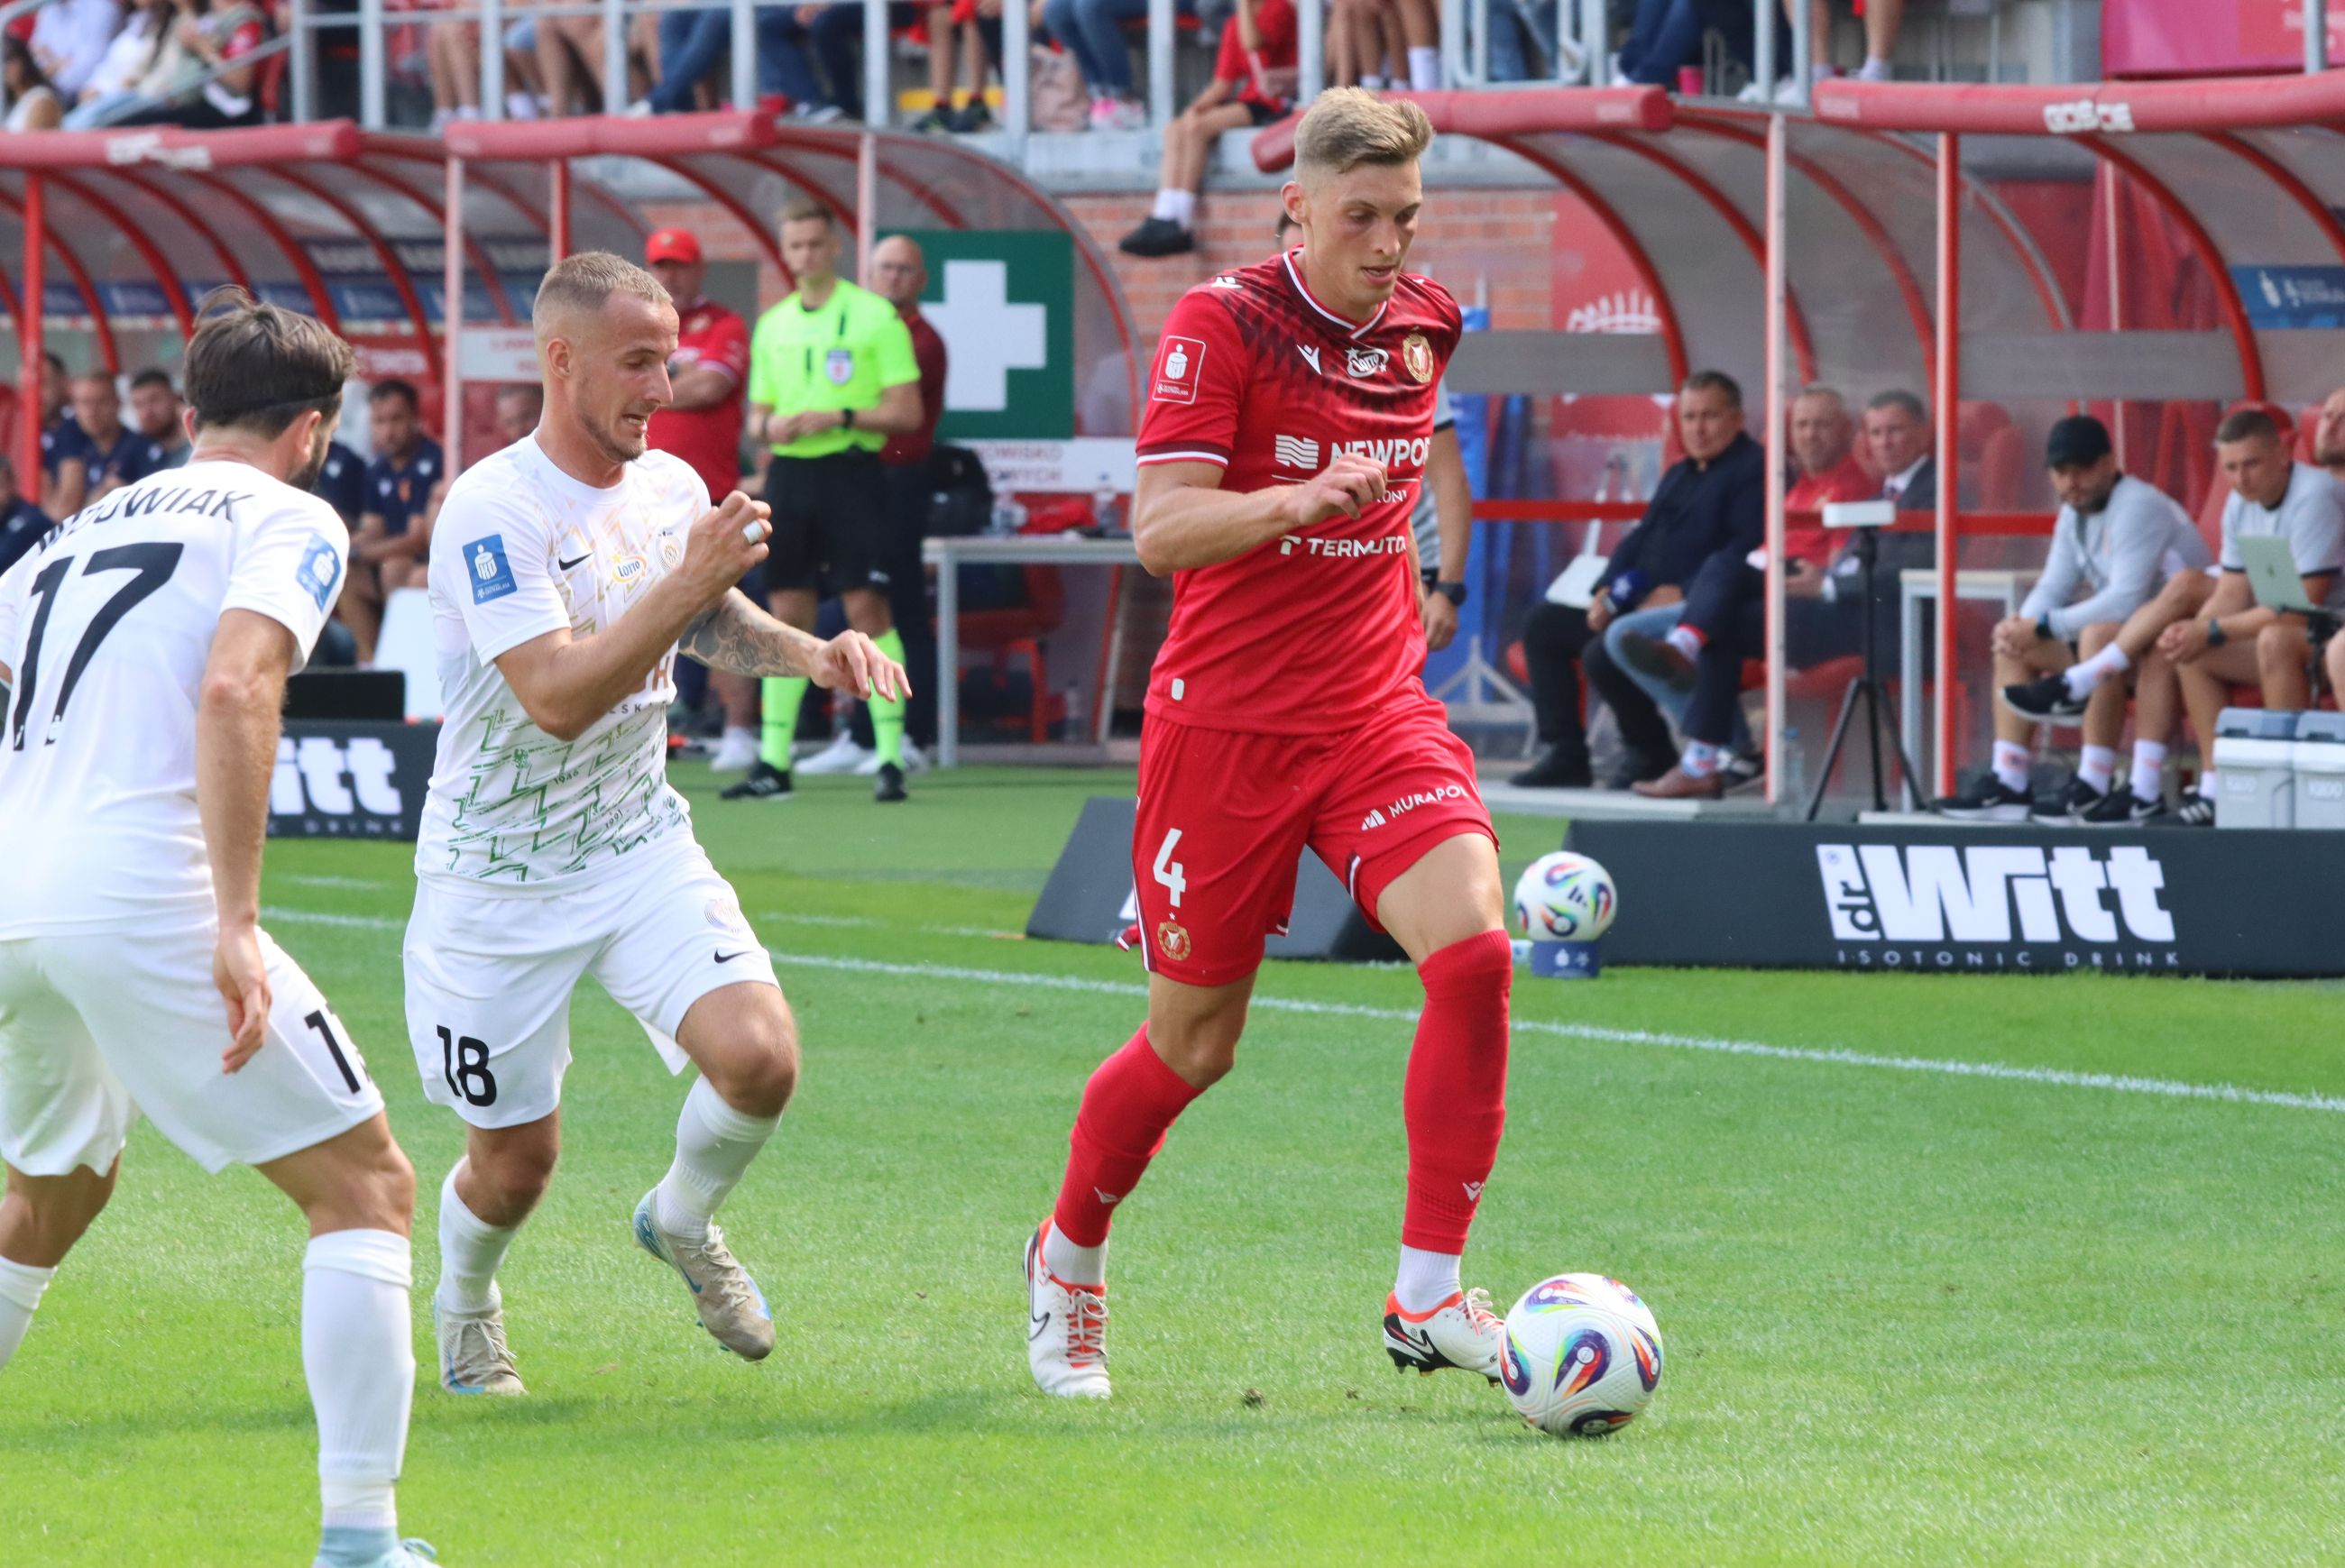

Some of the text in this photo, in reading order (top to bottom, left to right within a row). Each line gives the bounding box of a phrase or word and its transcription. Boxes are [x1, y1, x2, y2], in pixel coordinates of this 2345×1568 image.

[617, 560, 641, 578] LOTTO
[13, 542, 185, 751] 17
[270, 737, 403, 816] itt
[1153, 827, 1186, 909] 4
[1836, 845, 2176, 942] dr Witt
[1837, 949, 2179, 967] ISOTONIC DRINK
[304, 1003, 371, 1096] 1
[436, 1023, 498, 1108] 18
